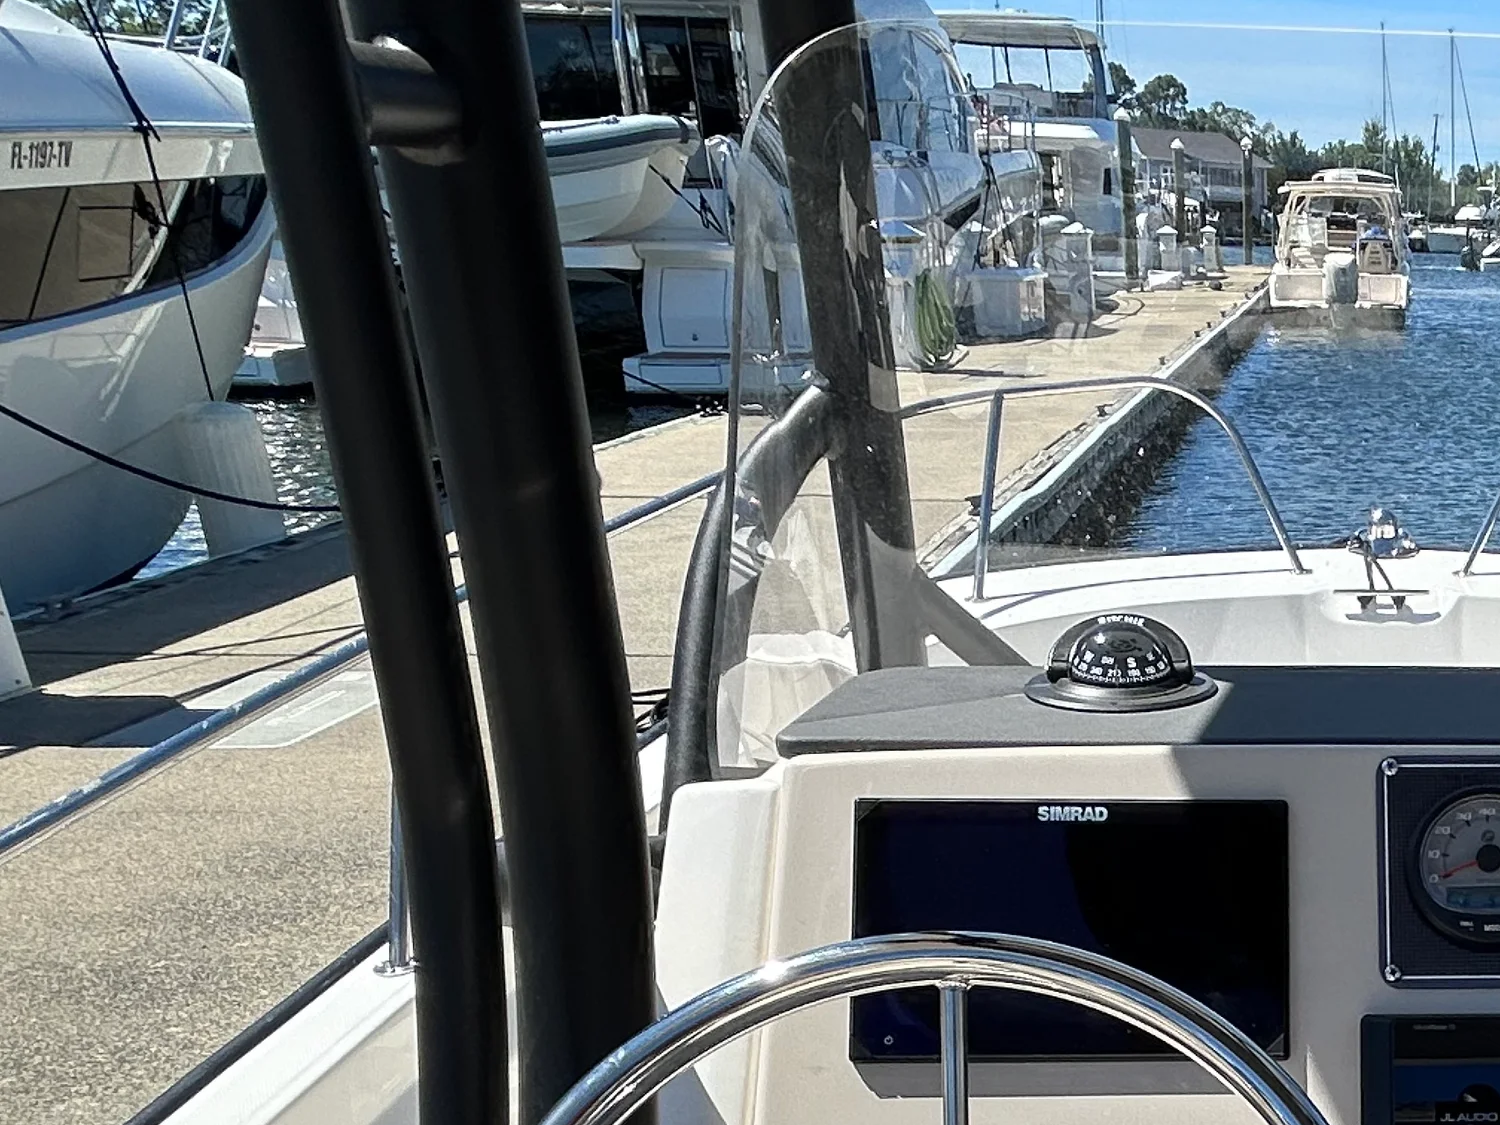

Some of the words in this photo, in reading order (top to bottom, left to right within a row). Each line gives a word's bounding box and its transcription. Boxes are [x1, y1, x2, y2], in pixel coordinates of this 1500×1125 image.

[1037, 806, 1108, 821] SIMRAD
[1457, 812, 1472, 821] 30
[1479, 808, 1496, 816] 40
[1435, 826, 1450, 835] 20
[1428, 851, 1440, 859] 10
[1429, 874, 1439, 883] 0
[1440, 1113, 1455, 1122] JL
[1457, 1112, 1498, 1121] AUDIO
